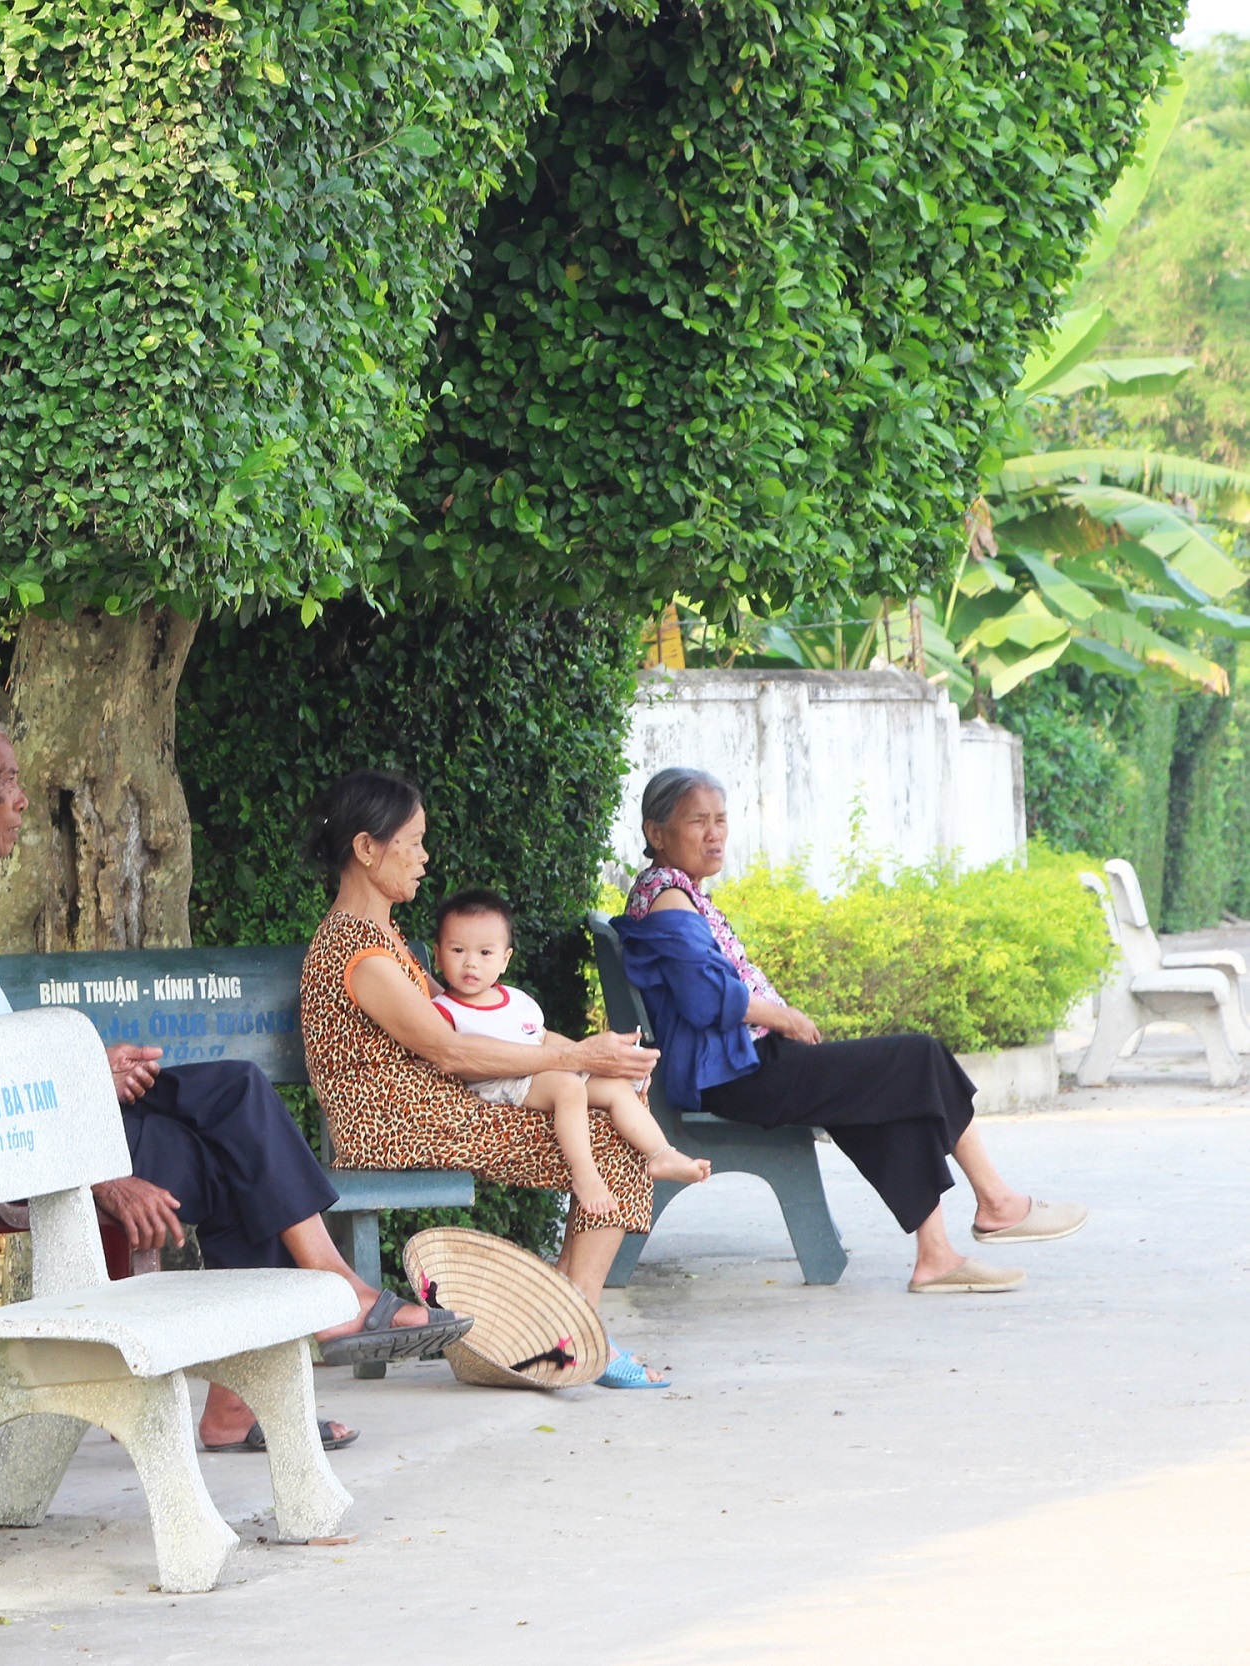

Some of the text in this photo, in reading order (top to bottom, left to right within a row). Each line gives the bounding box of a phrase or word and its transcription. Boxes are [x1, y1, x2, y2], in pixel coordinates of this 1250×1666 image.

[39, 978, 80, 1005] BÌNH
[83, 976, 138, 1007] THUẬN
[153, 974, 193, 1001] KÍNH
[197, 972, 242, 1004] TẶNG
[1, 1079, 25, 1117] BÀ
[23, 1079, 58, 1113] TAM
[7, 1125, 35, 1157] tặng
